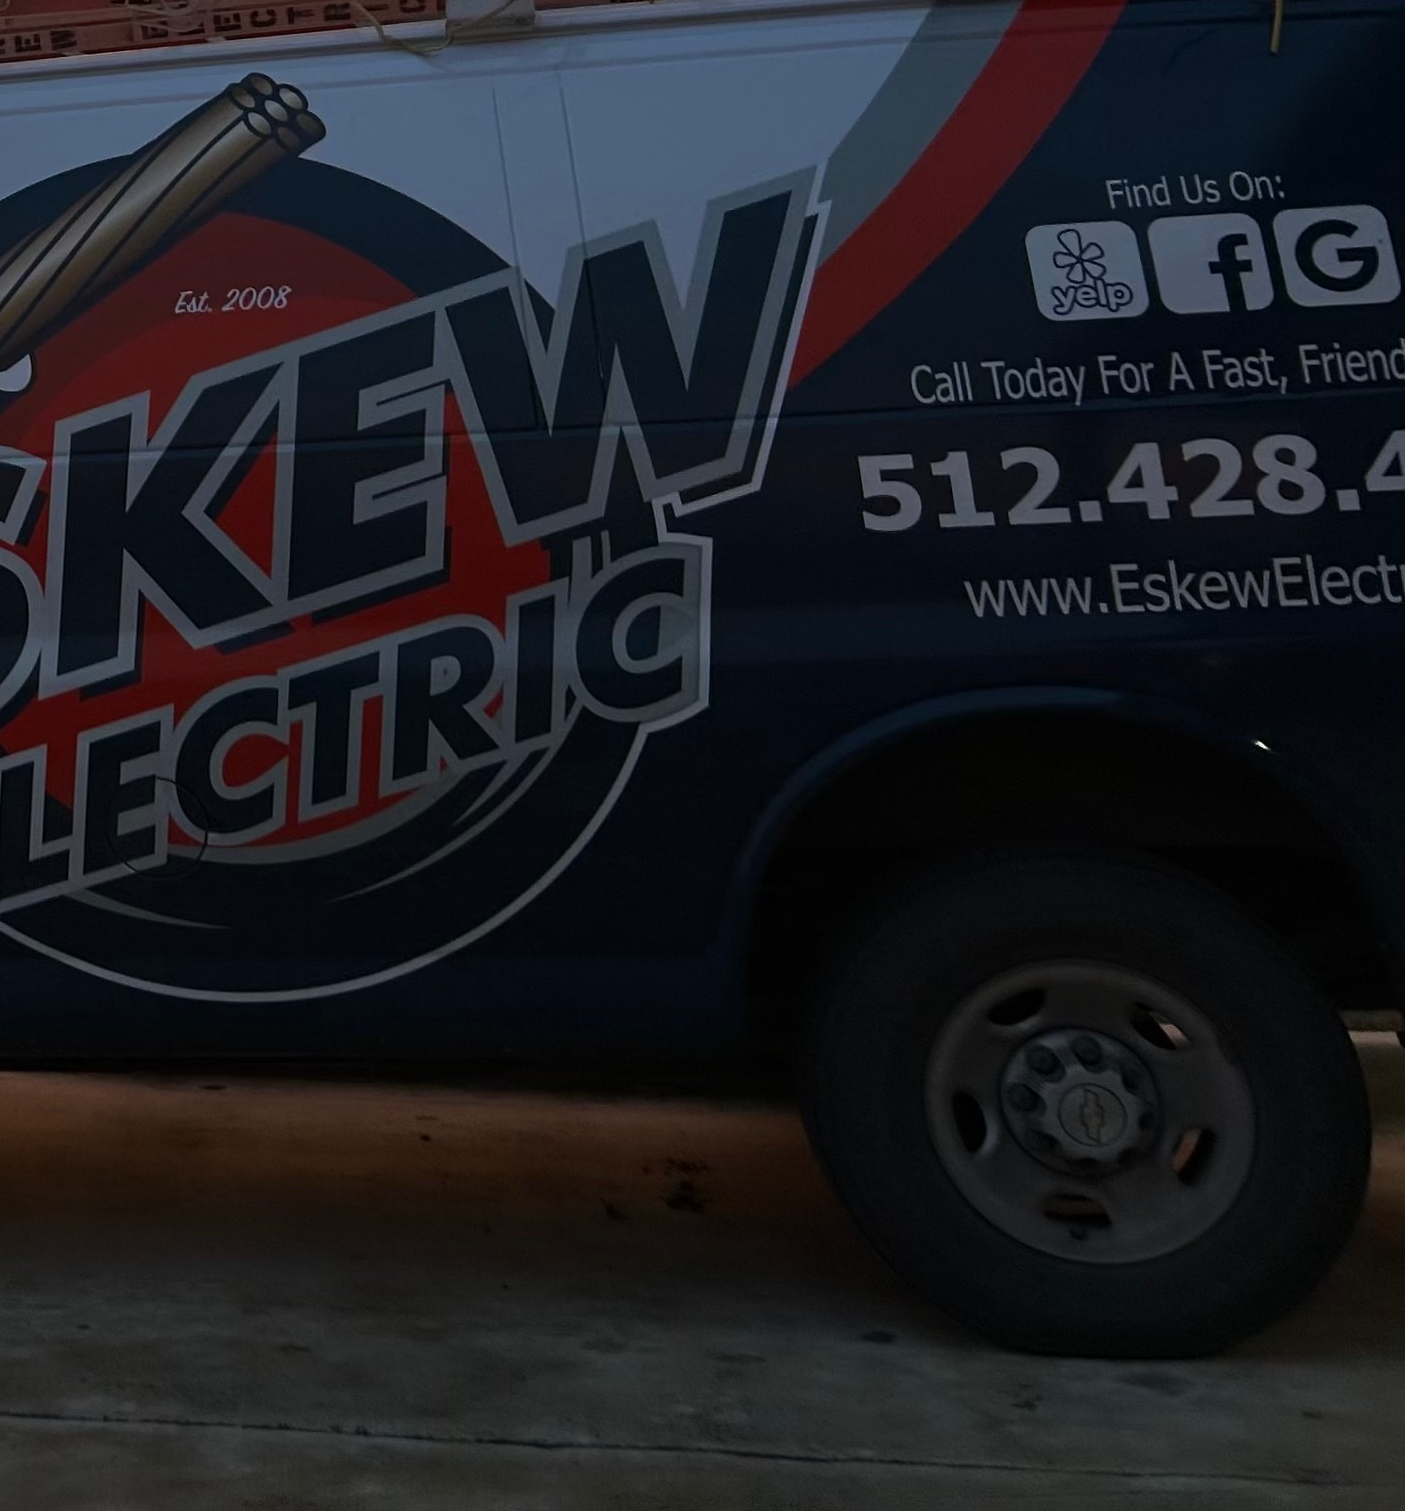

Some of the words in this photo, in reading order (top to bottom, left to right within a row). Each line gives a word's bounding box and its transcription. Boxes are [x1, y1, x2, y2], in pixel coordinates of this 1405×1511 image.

[1105, 175, 1171, 210] Find
[1179, 173, 1221, 205] Us
[1228, 170, 1286, 201] On:
[1294, 218, 1380, 293] G
[174, 290, 213, 314] Est.
[221, 285, 294, 312] 2008
[1051, 277, 1133, 316] yelp
[910, 361, 973, 404] Call
[980, 357, 1086, 406] Today
[1097, 354, 1155, 394] For
[1169, 351, 1195, 391] A
[1201, 348, 1288, 395] Fast,
